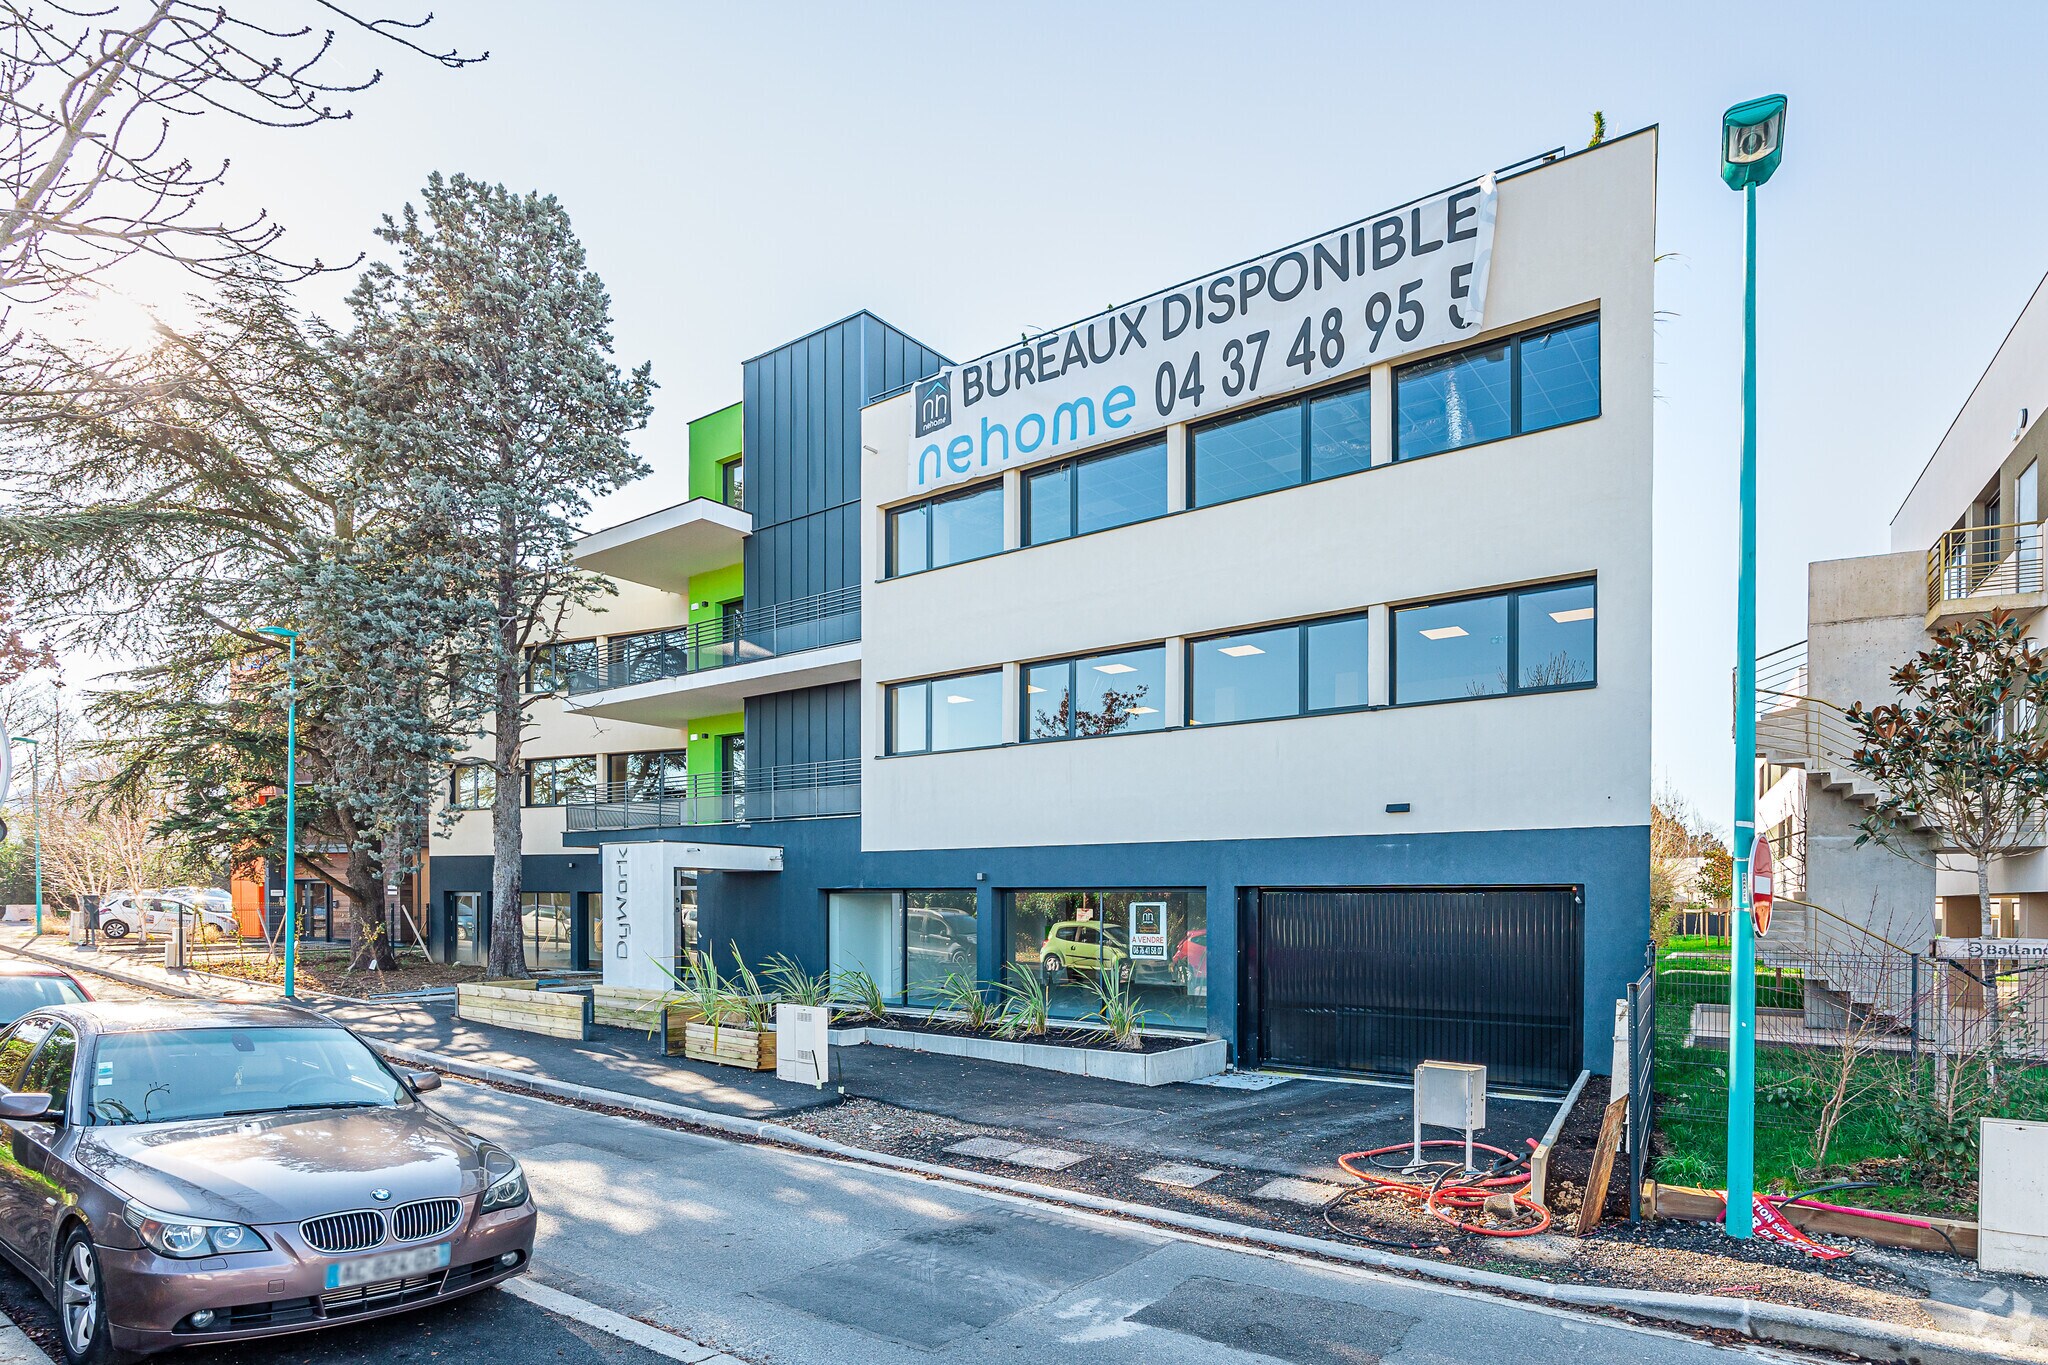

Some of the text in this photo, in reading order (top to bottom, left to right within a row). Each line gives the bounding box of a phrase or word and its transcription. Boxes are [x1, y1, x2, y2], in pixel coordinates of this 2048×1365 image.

[963, 185, 1481, 408] BUREAUX DISPONIBLE
[1155, 351, 1205, 416] 04
[1221, 329, 1271, 397] 37
[1286, 306, 1346, 376] 48
[1364, 278, 1425, 353] 95
[918, 385, 1137, 485] nehome
[1752, 1196, 1776, 1223] TION
